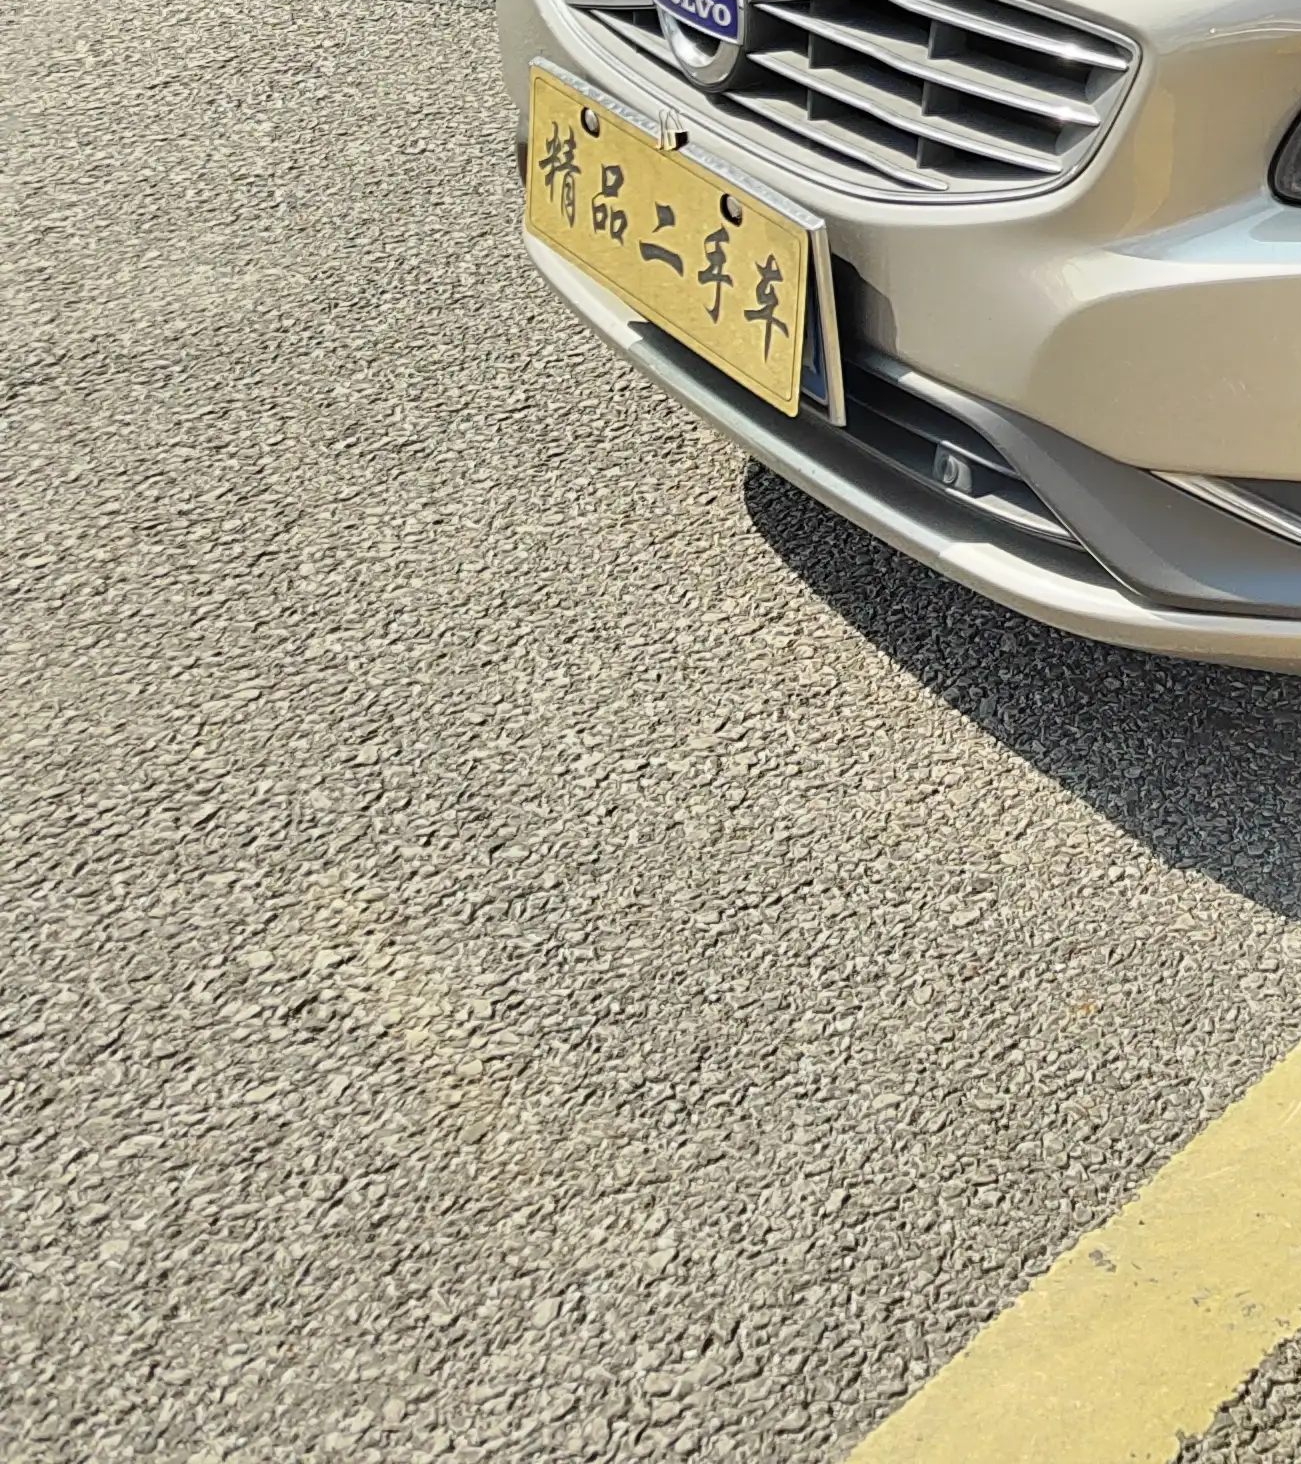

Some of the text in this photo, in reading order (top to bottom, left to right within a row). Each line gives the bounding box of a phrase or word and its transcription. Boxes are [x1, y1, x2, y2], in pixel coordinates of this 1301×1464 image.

[538, 120, 789, 364] 精品二手车
